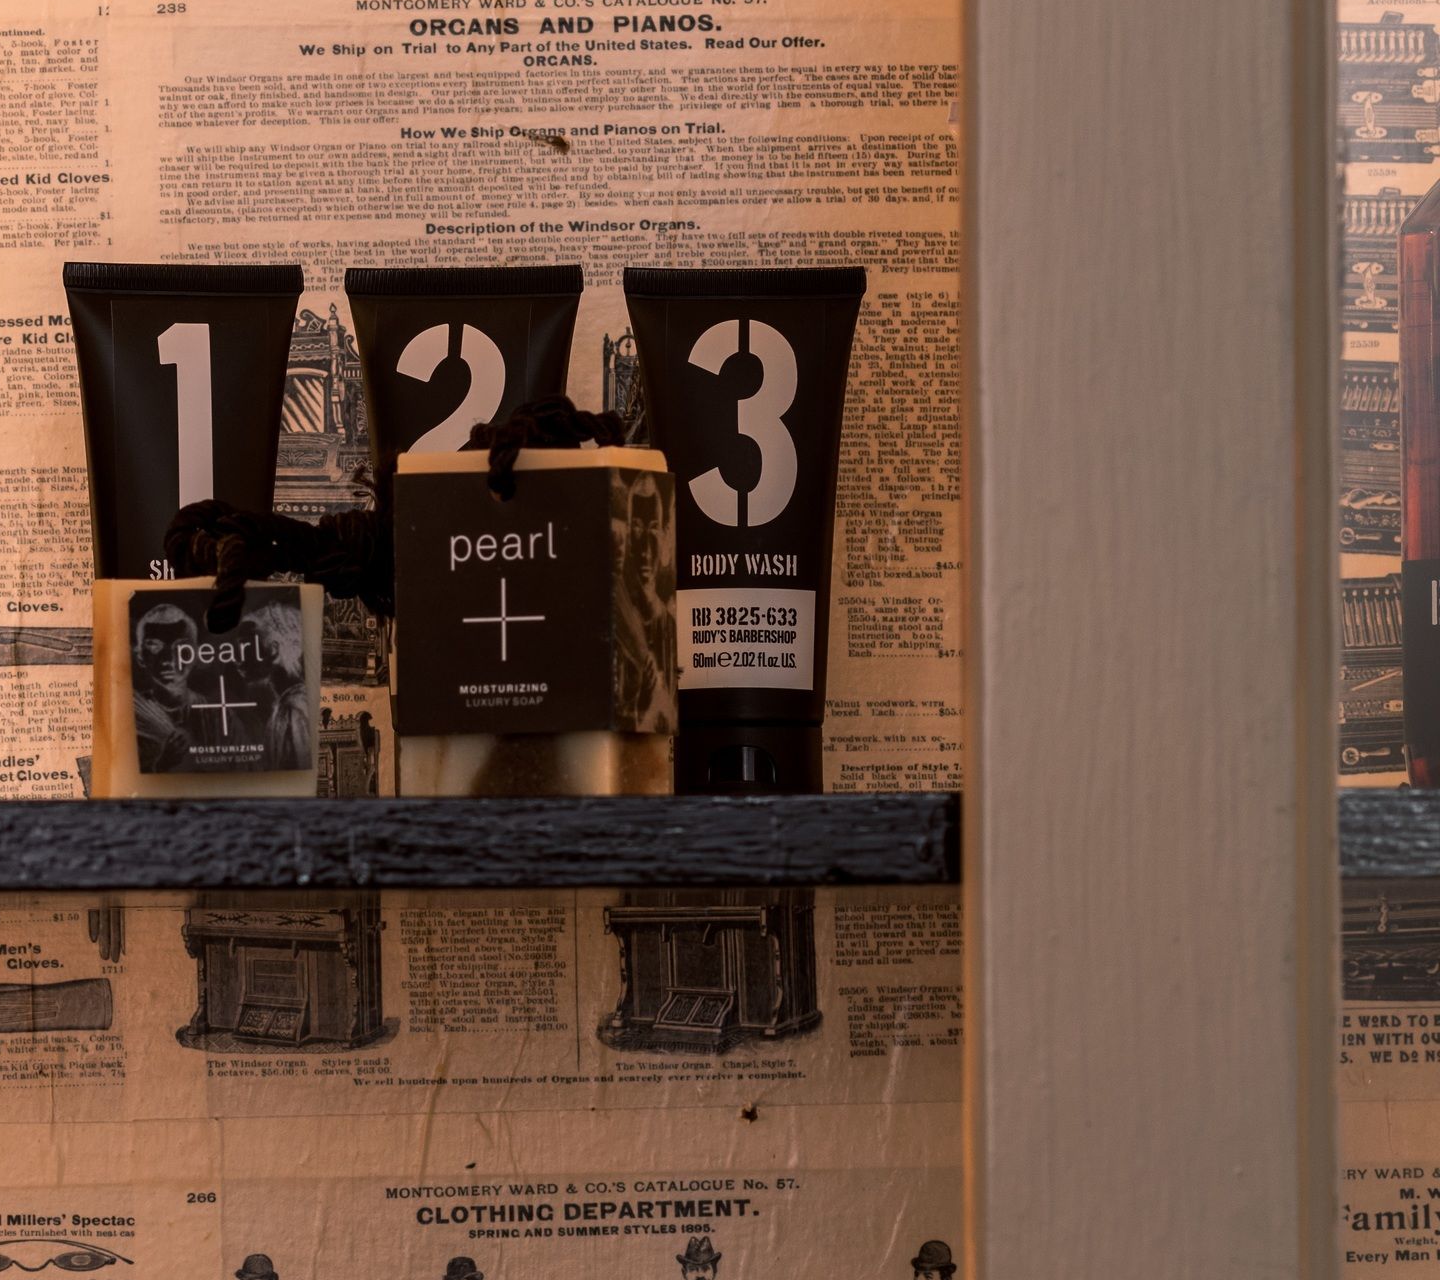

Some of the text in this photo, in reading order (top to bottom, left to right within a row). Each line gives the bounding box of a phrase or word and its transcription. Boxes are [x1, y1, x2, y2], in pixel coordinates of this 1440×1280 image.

[156, 2, 187, 15] 238
[409, 14, 722, 37] ORGANS AND PIANOS.
[157, 322, 214, 519] 1
[687, 319, 798, 528] 3
[450, 522, 558, 571] pearl
[691, 554, 797, 576] BODY WASH
[692, 607, 711, 626] RB
[693, 630, 796, 644] RUDY'S BARBERSHOP
[176, 635, 263, 670] pearl
[693, 653, 716, 668] 60ml
[733, 652, 755, 667] 2.02
[460, 684, 548, 695] MOISTURIZING
[189, 744, 264, 753] MOISTURIZING
[186, 1192, 217, 1204] 266
[416, 1198, 760, 1225] CLOTHING DEPARTMENT.
